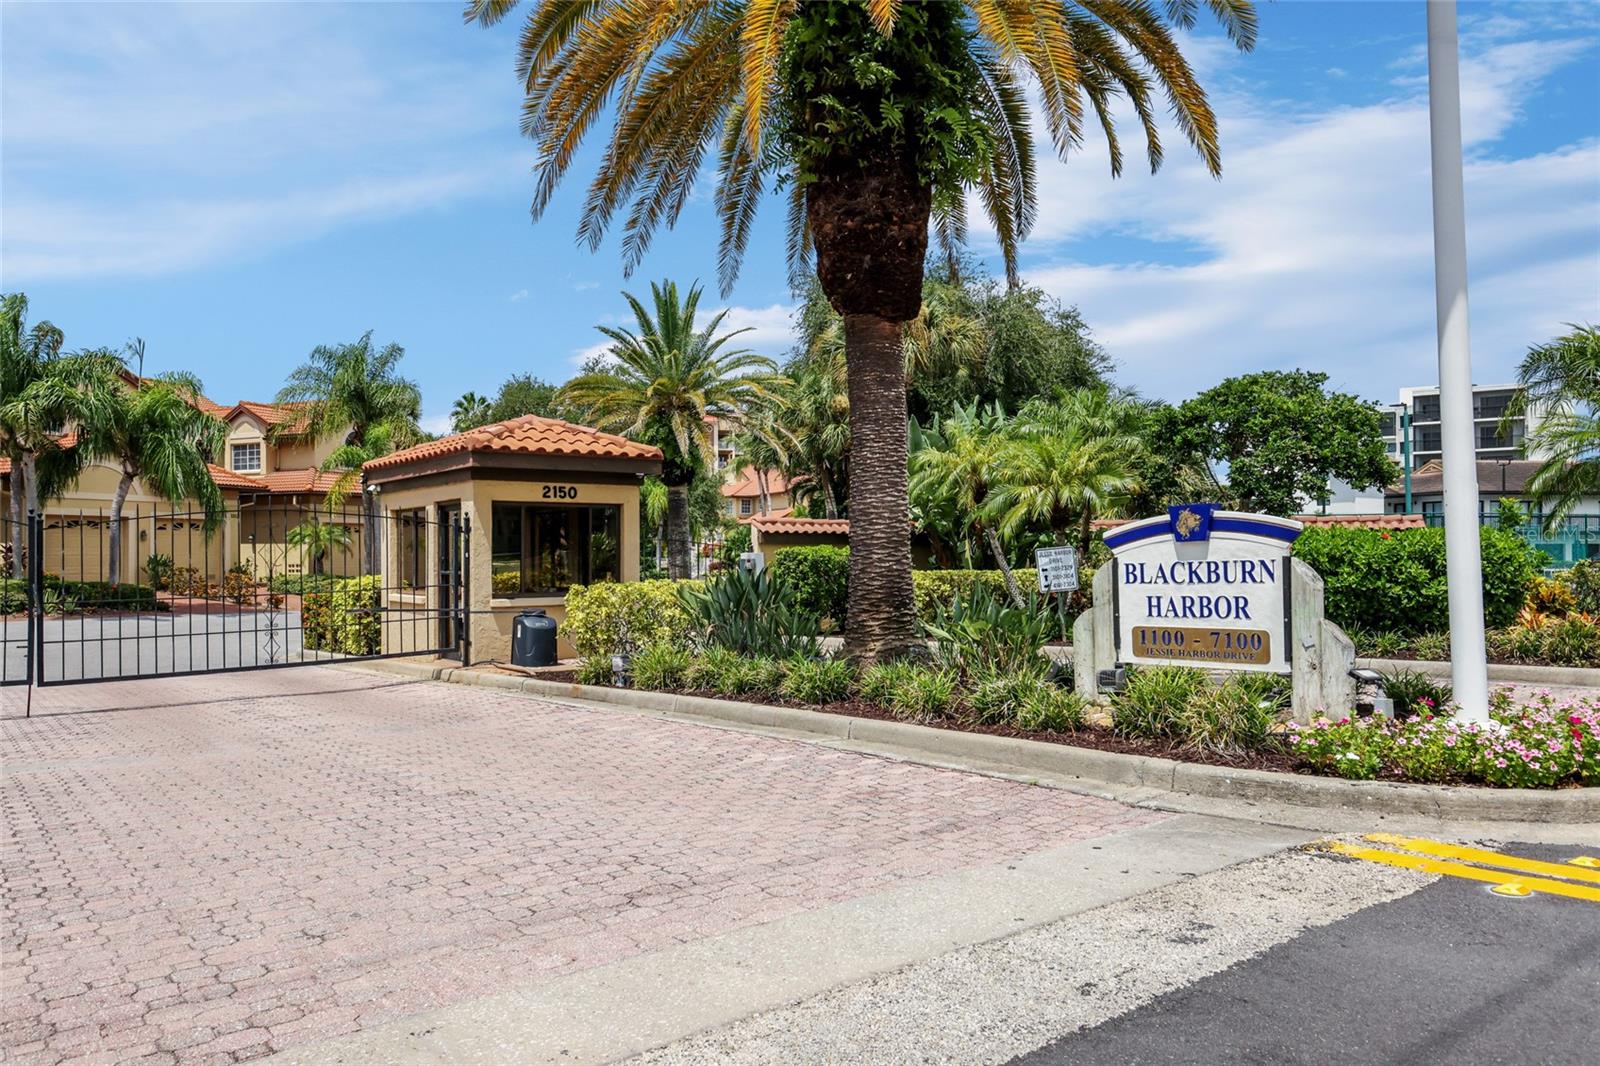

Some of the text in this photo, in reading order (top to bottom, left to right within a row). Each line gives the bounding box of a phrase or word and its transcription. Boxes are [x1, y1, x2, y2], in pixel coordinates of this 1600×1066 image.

[542, 485, 578, 500] 2150
[1124, 559, 1277, 585] BLACKBURN
[1146, 595, 1251, 620] HARBOR
[1139, 629, 1185, 647] 1100
[1209, 631, 1262, 651] 7100
[1145, 647, 1256, 661] JESSIE HARBOR DRIVE
